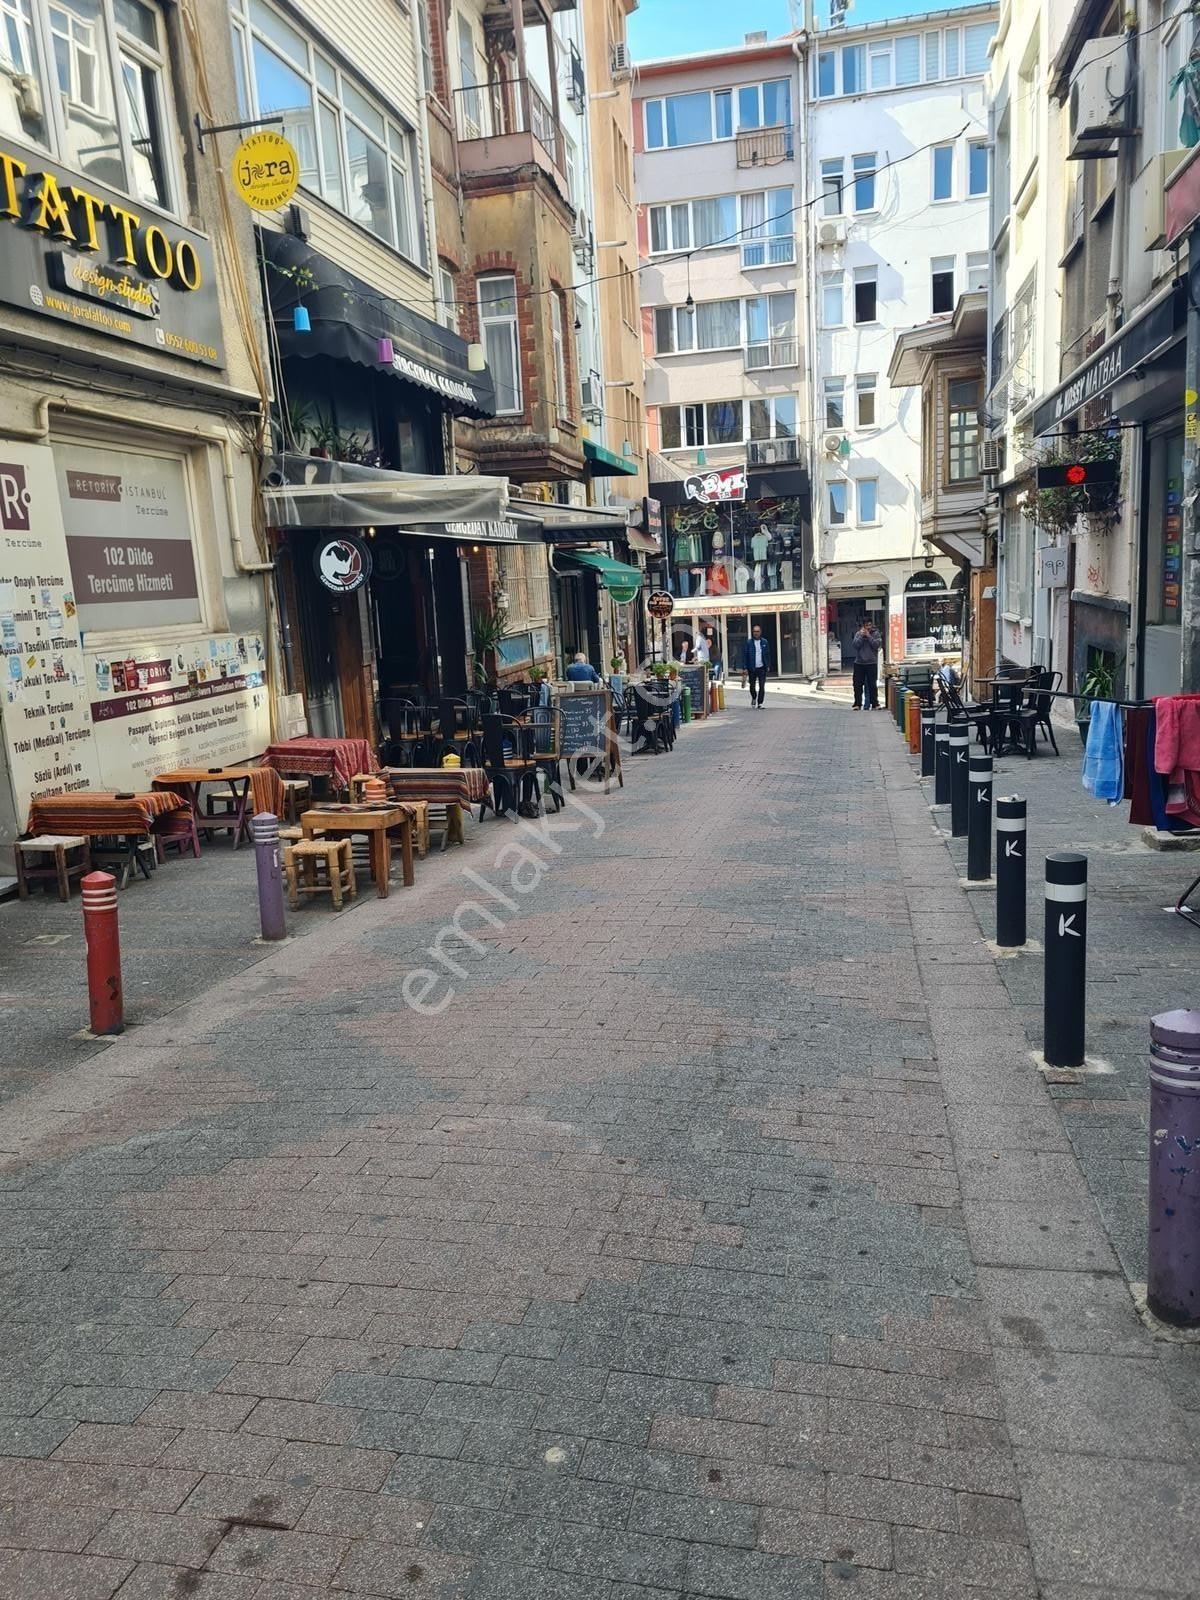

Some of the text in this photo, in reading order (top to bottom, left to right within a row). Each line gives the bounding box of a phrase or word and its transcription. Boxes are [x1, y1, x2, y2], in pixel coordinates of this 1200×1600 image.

[247, 135, 281, 150] TATTOO
[251, 190, 289, 206] PIERCING
[0, 153, 202, 291] TATTOO
[1085, 345, 1122, 399] MATBAA
[75, 479, 117, 495] RETORİK
[136, 505, 169, 517] Tercüme
[488, 519, 518, 540] KADIKÖY
[5, 538, 42, 548] Tercüme
[103, 546, 154, 566] 102 Dilde
[14, 576, 36, 589] Onaylı
[37, 575, 64, 586] Tercüme
[88, 572, 174, 595] Tercüme Hizmeti
[929, 626, 942, 634] UV
[51, 637, 78, 651] Tercüme
[24, 702, 74, 719] Teknik Tercüme
[128, 723, 154, 737] Pasaport,
[14, 728, 91, 754] Tıbbi (Medikal) Tercüme
[34, 768, 52, 783] Sözlü
[74, 763, 82, 772] ve
[31, 778, 90, 801] Simultane Tercüme
